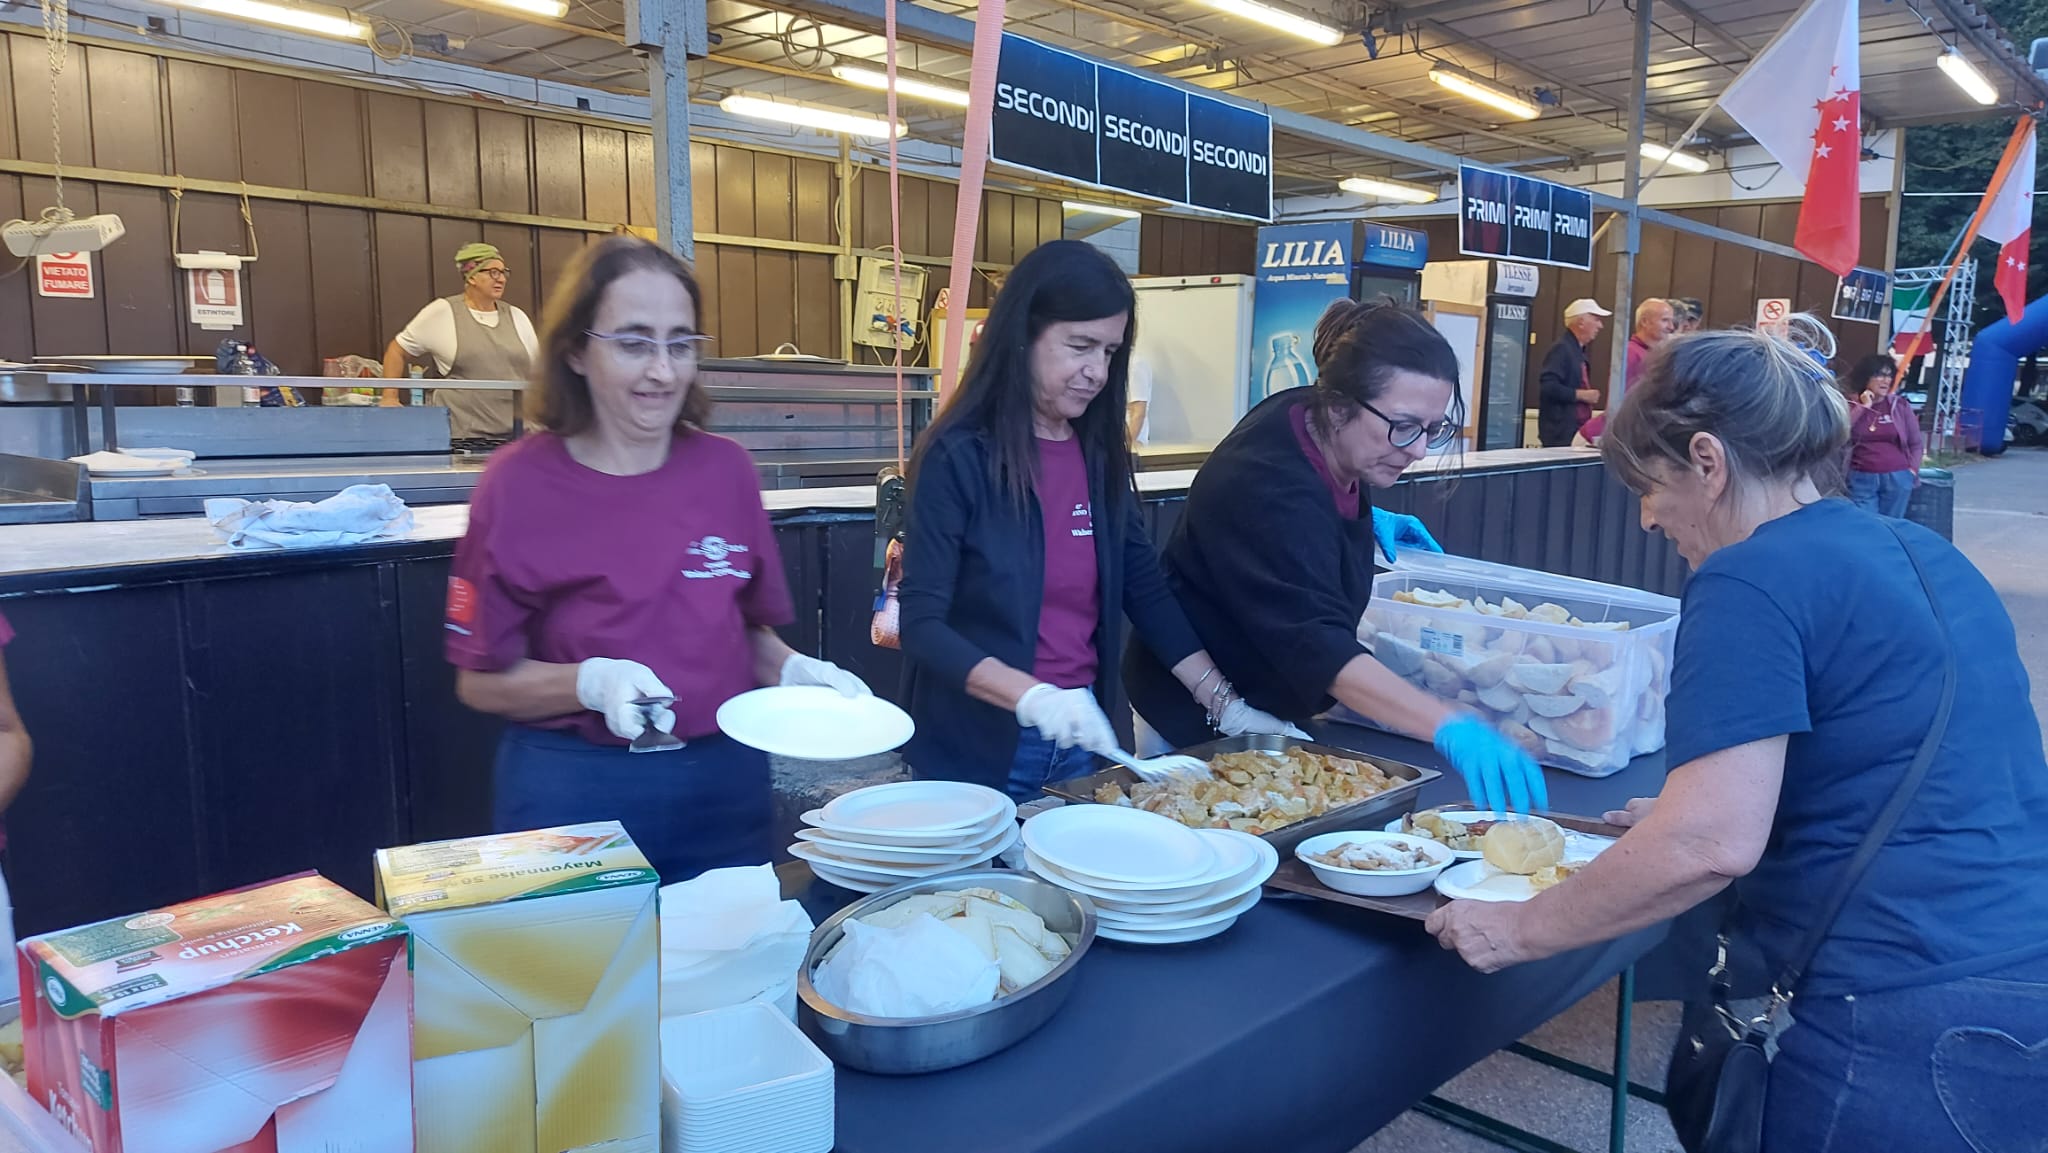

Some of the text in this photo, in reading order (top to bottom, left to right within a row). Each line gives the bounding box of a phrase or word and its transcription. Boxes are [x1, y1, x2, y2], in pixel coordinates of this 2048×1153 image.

[997, 83, 1266, 176] SECONDI SECONDI SECONDI
[1467, 197, 1588, 238] PRIMI PRIMI PRIMI
[1380, 229, 1415, 252] LILIA
[1262, 239, 1345, 268] LILIA
[43, 266, 88, 278] VIETATO
[44, 279, 89, 291] FUMARE
[197, 308, 236, 317] ESTINTORE
[489, 859, 603, 881] Mayonnaise
[178, 921, 303, 961] Ketchup
[346, 925, 384, 938] SENNA
